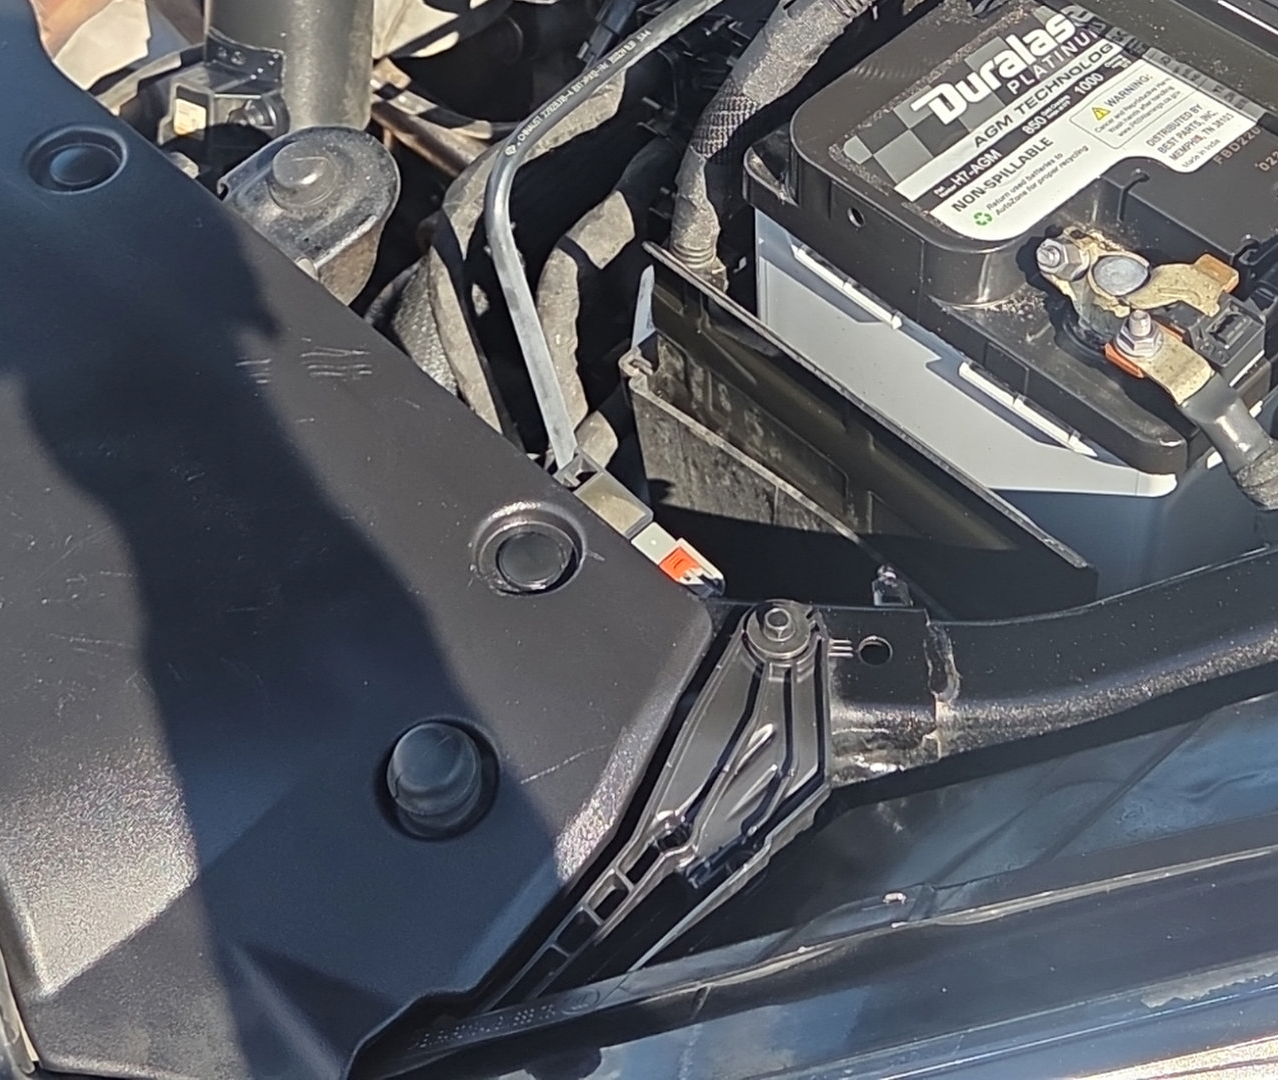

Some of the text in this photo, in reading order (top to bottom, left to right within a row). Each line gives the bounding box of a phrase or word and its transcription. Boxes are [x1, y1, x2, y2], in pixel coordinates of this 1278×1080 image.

[911, 13, 1076, 125] Duralas
[1072, 71, 1105, 95] 1000
[973, 114, 1014, 148] AGM
[1012, 42, 1115, 115] TECHNOLOG
[1103, 72, 1153, 107] WARNING:
[1138, 100, 1153, 111] after
[1020, 114, 1048, 134] 850
[1094, 117, 1115, 133] Cancer
[1112, 109, 1126, 119] and
[1144, 103, 1204, 147] DISTRIBUTED BY
[1156, 108, 1219, 154] BEST PARTS, INC.
[1167, 132, 1207, 161] MEMPHIS,
[1201, 125, 1216, 135] TN
[1181, 153, 1201, 167] Made
[1203, 138, 1221, 150] India
[950, 148, 1003, 186] H7-AGM
[950, 136, 1054, 212] NON-SPILLABLE
[985, 190, 1012, 210] Return
[1008, 178, 1028, 193] used
[1024, 157, 1057, 181] batteries
[993, 144, 1090, 216] AutoZone for proper recycling
